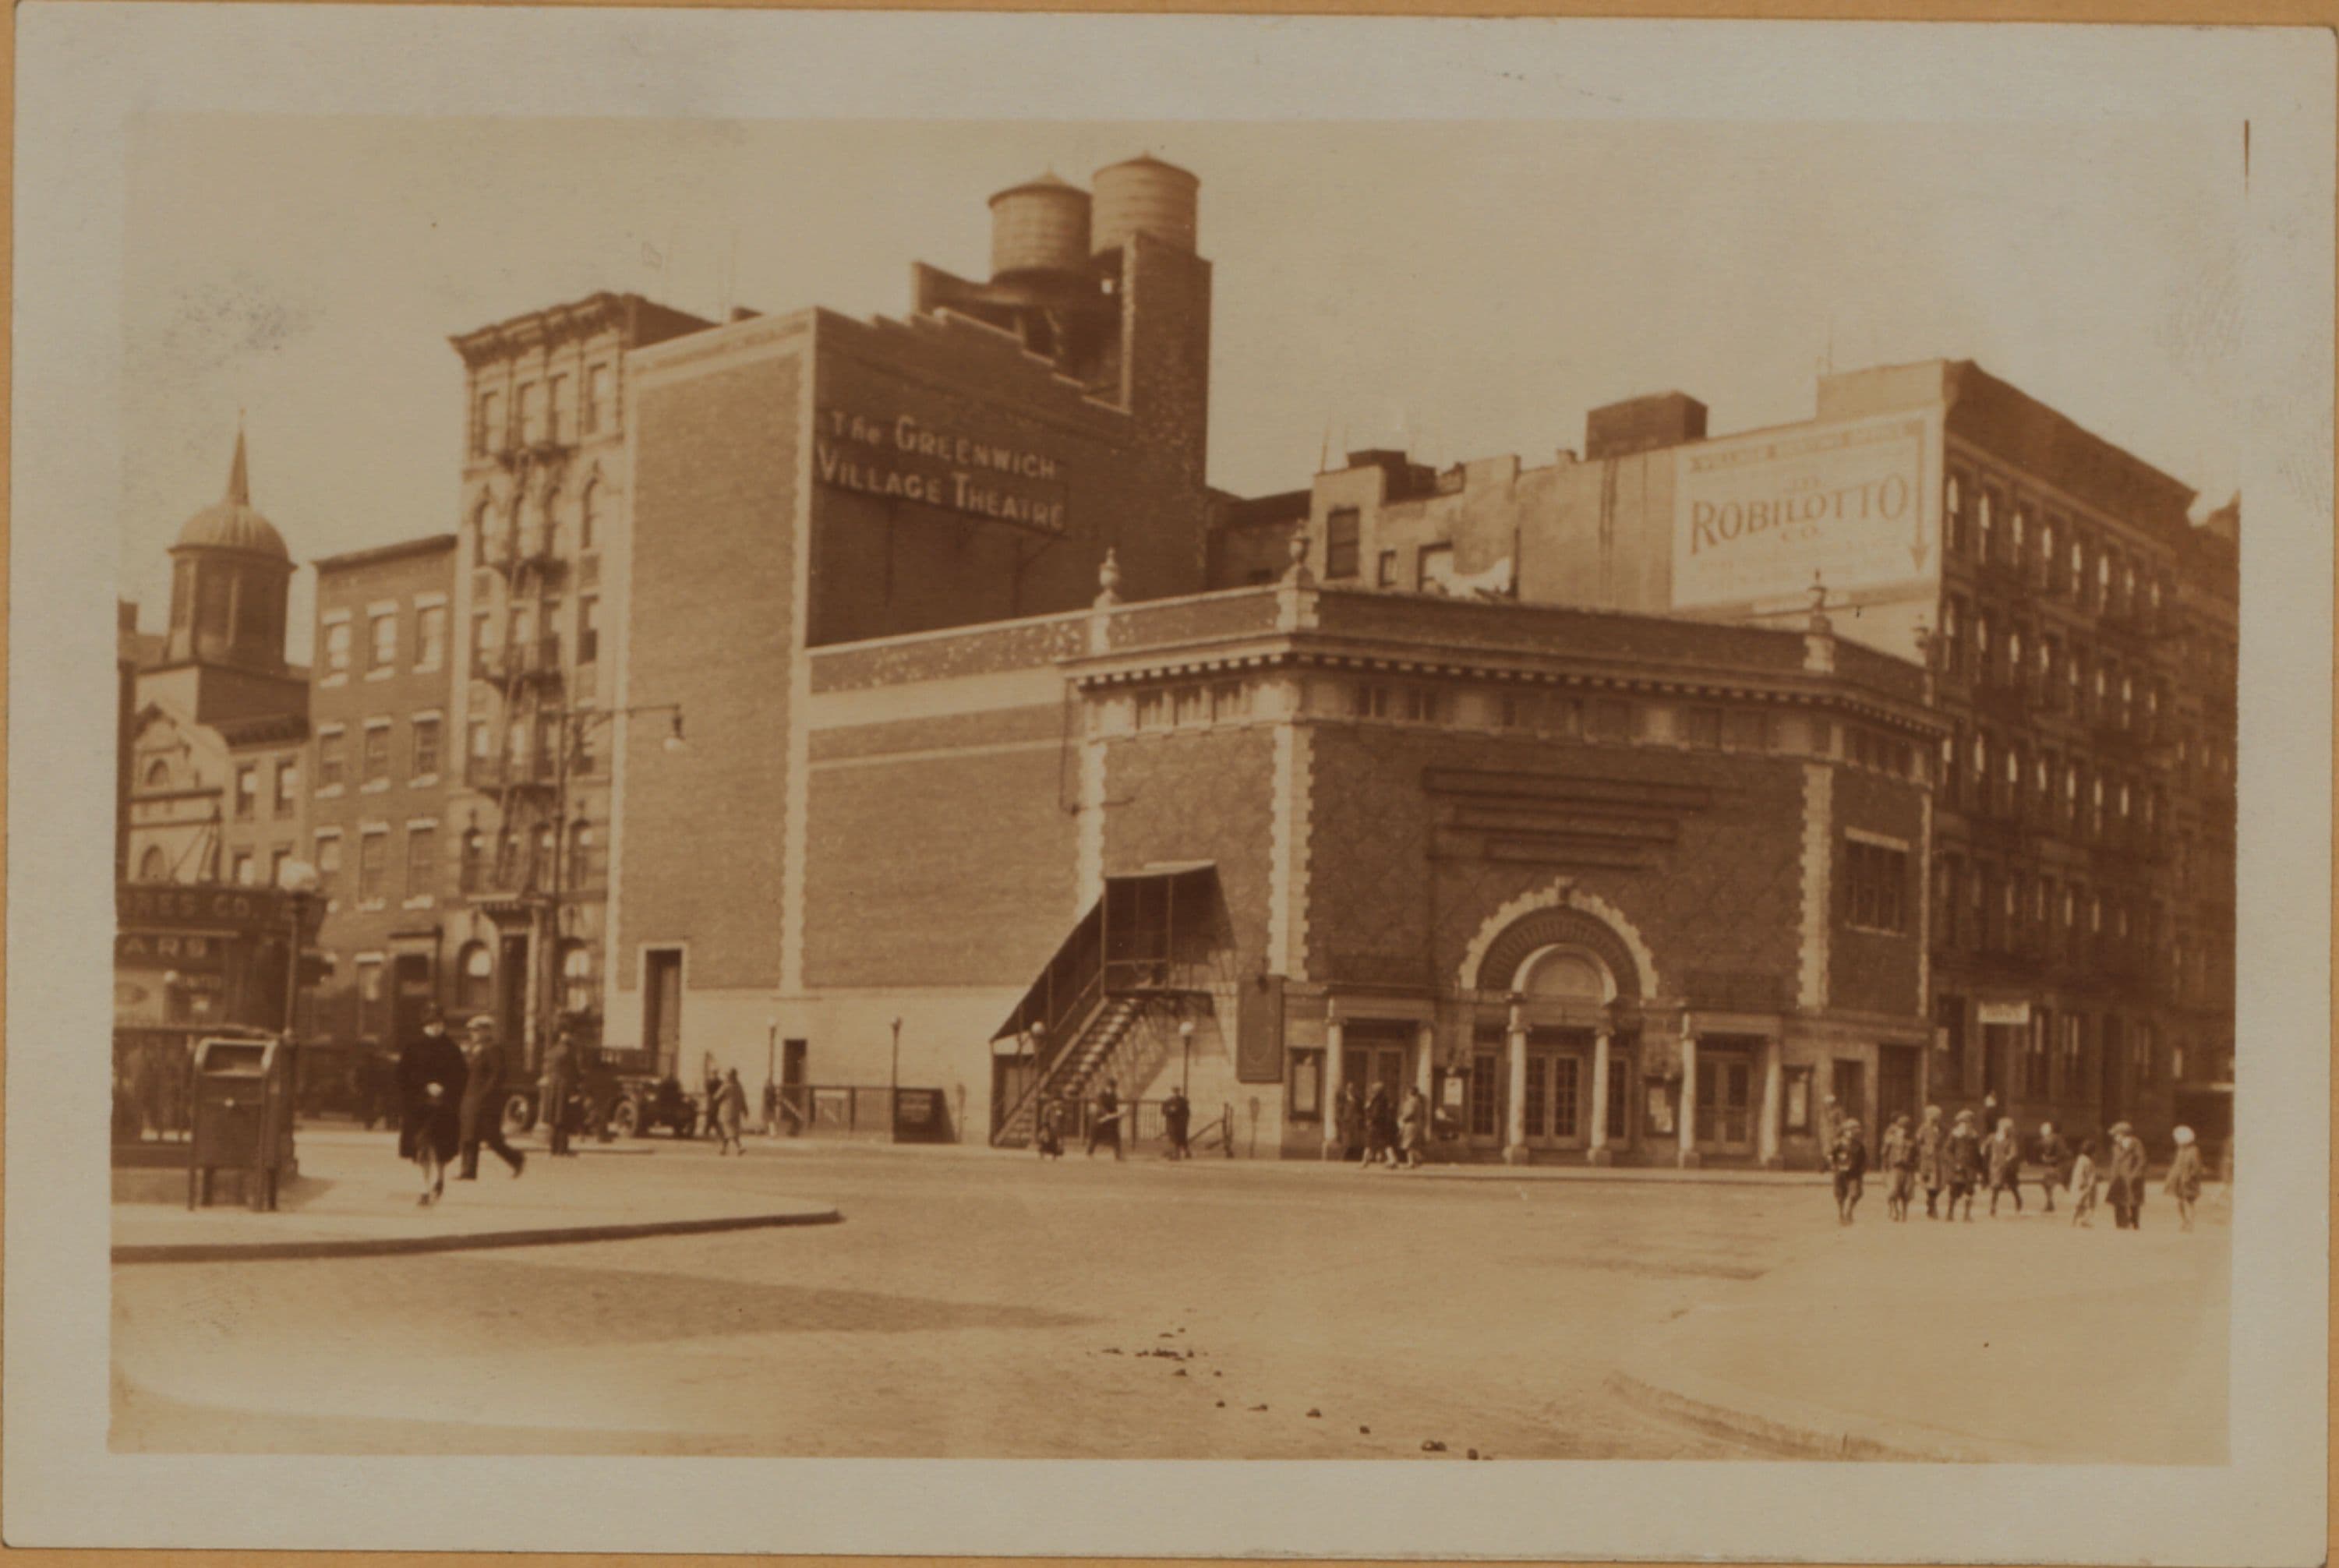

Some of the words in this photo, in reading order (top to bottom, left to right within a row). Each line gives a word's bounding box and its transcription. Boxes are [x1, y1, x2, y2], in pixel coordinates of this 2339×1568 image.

[818, 442, 942, 505] VILLAGE
[952, 471, 1065, 531] THEATRE
[895, 414, 1057, 480] GREENWICH
[1691, 473, 1908, 556] ROBILOTTO
